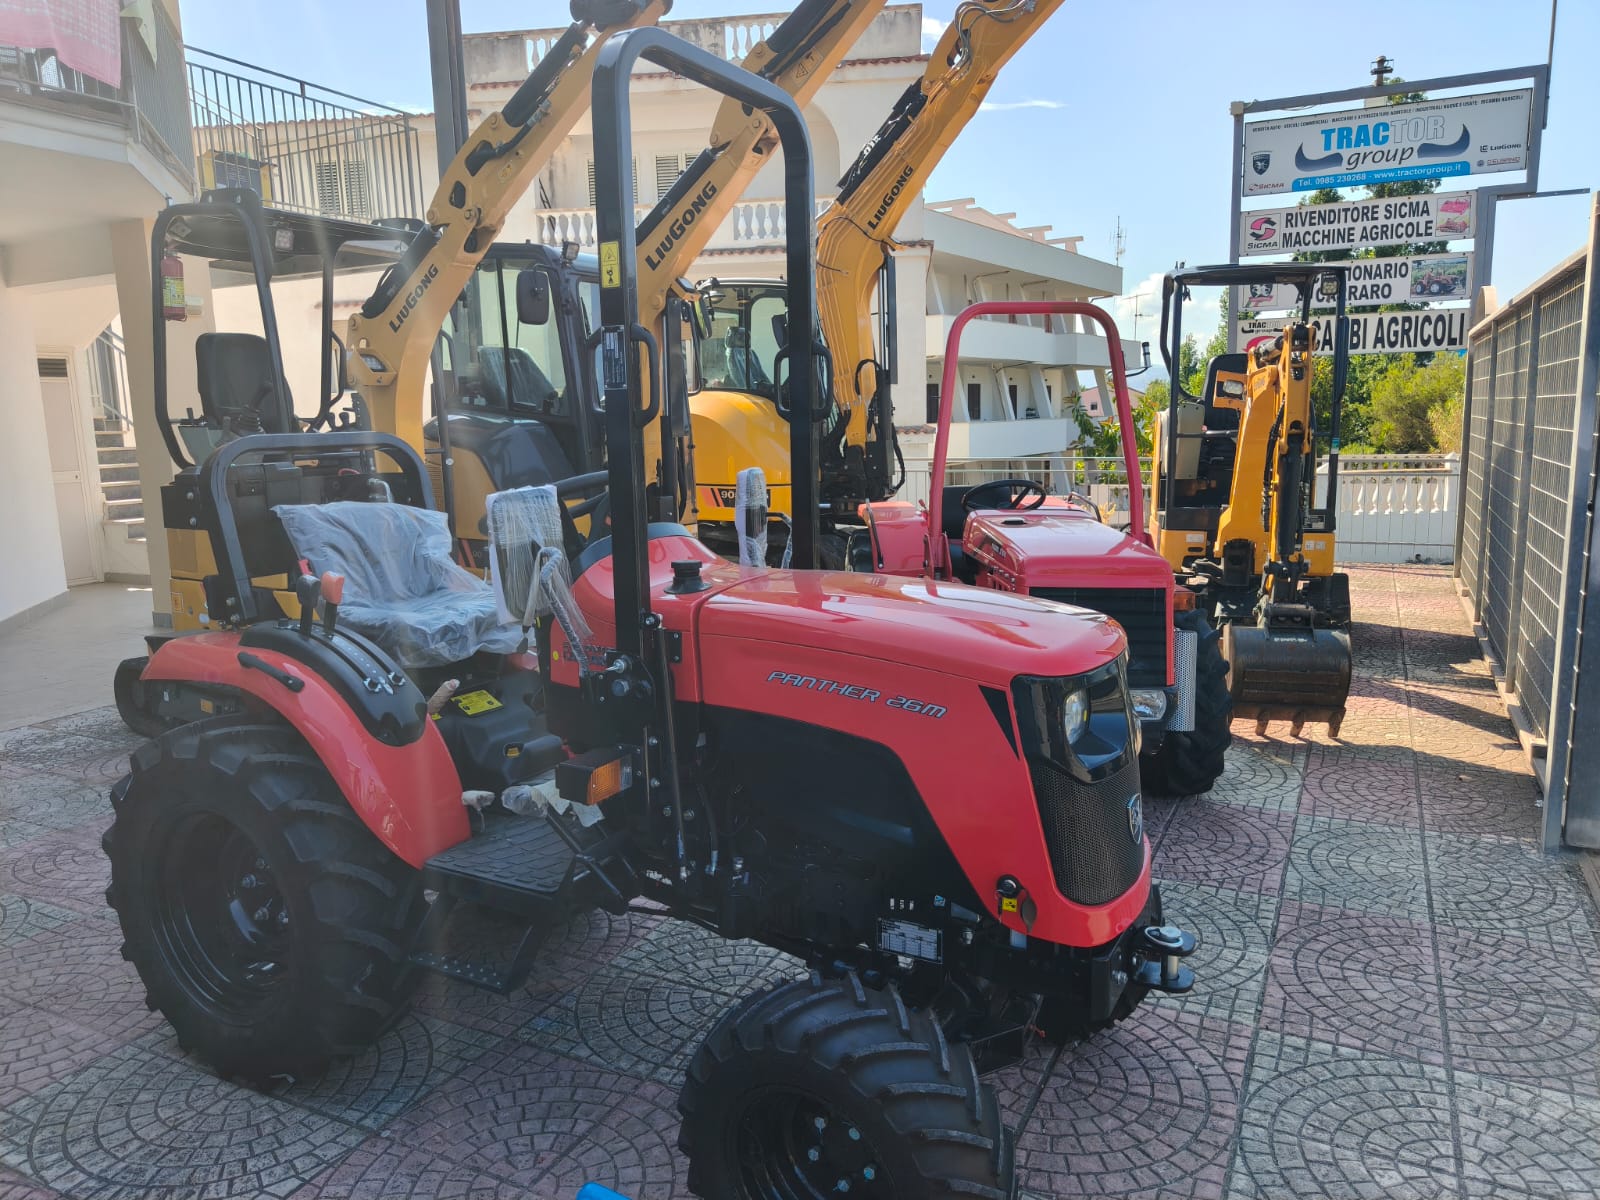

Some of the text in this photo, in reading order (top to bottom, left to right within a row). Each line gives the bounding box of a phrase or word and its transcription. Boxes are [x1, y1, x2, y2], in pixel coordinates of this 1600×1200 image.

[1320, 115, 1445, 151] TRACTOR
[1345, 146, 1414, 171] group
[1299, 179, 1313, 187] Tel.
[1316, 177, 1335, 185] 0985
[1336, 173, 1367, 183] 230268
[1374, 163, 1461, 179] www.tractorgroup.it
[645, 181, 718, 271] LIUGONG
[1285, 200, 1430, 229] RIVENDITORE SICMA
[1282, 220, 1433, 249] MACCHINE AGRICOLE
[1374, 313, 1465, 349] AGRICOLI
[767, 670, 948, 719] PANTHER 26M
